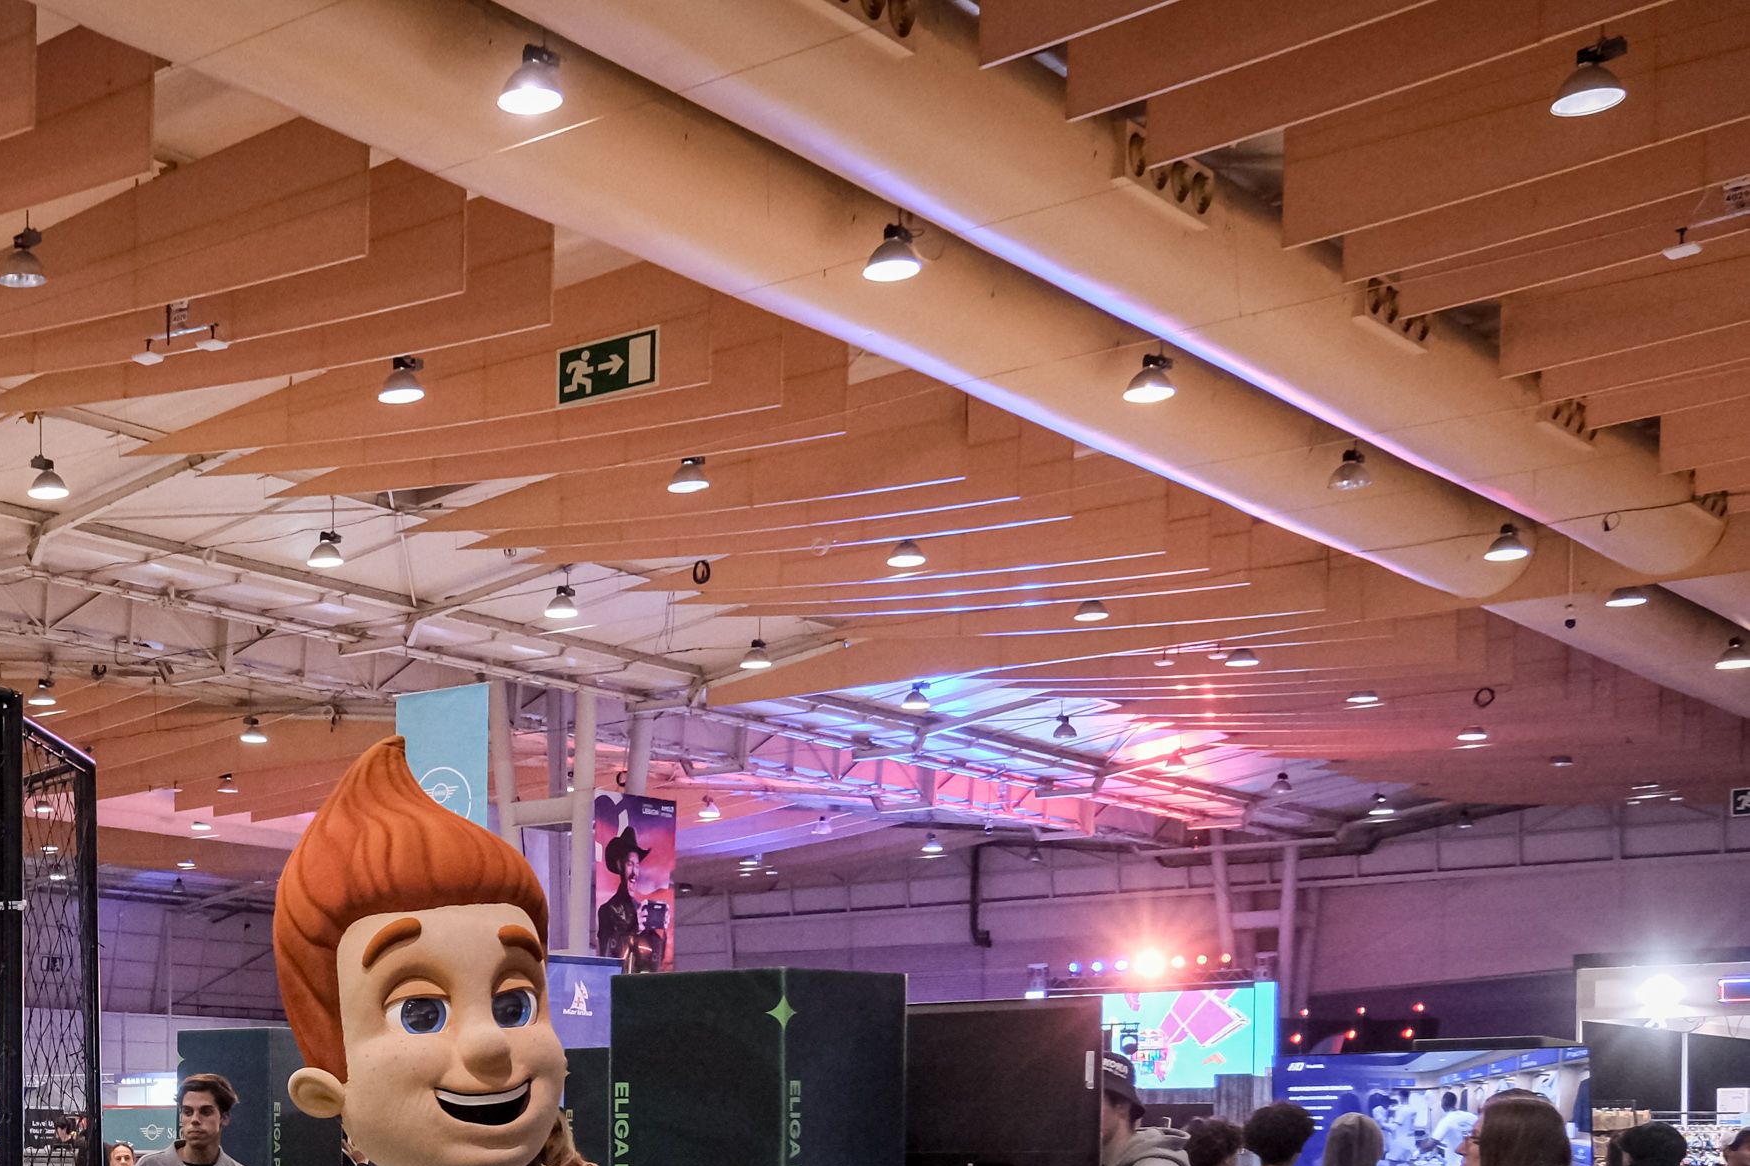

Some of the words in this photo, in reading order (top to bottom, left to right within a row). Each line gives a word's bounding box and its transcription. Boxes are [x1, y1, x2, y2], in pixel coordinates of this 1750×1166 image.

[273, 1102, 281, 1153] ELIGA
[613, 1081, 630, 1158] ELIGA
[789, 1079, 801, 1159] ELIGA
